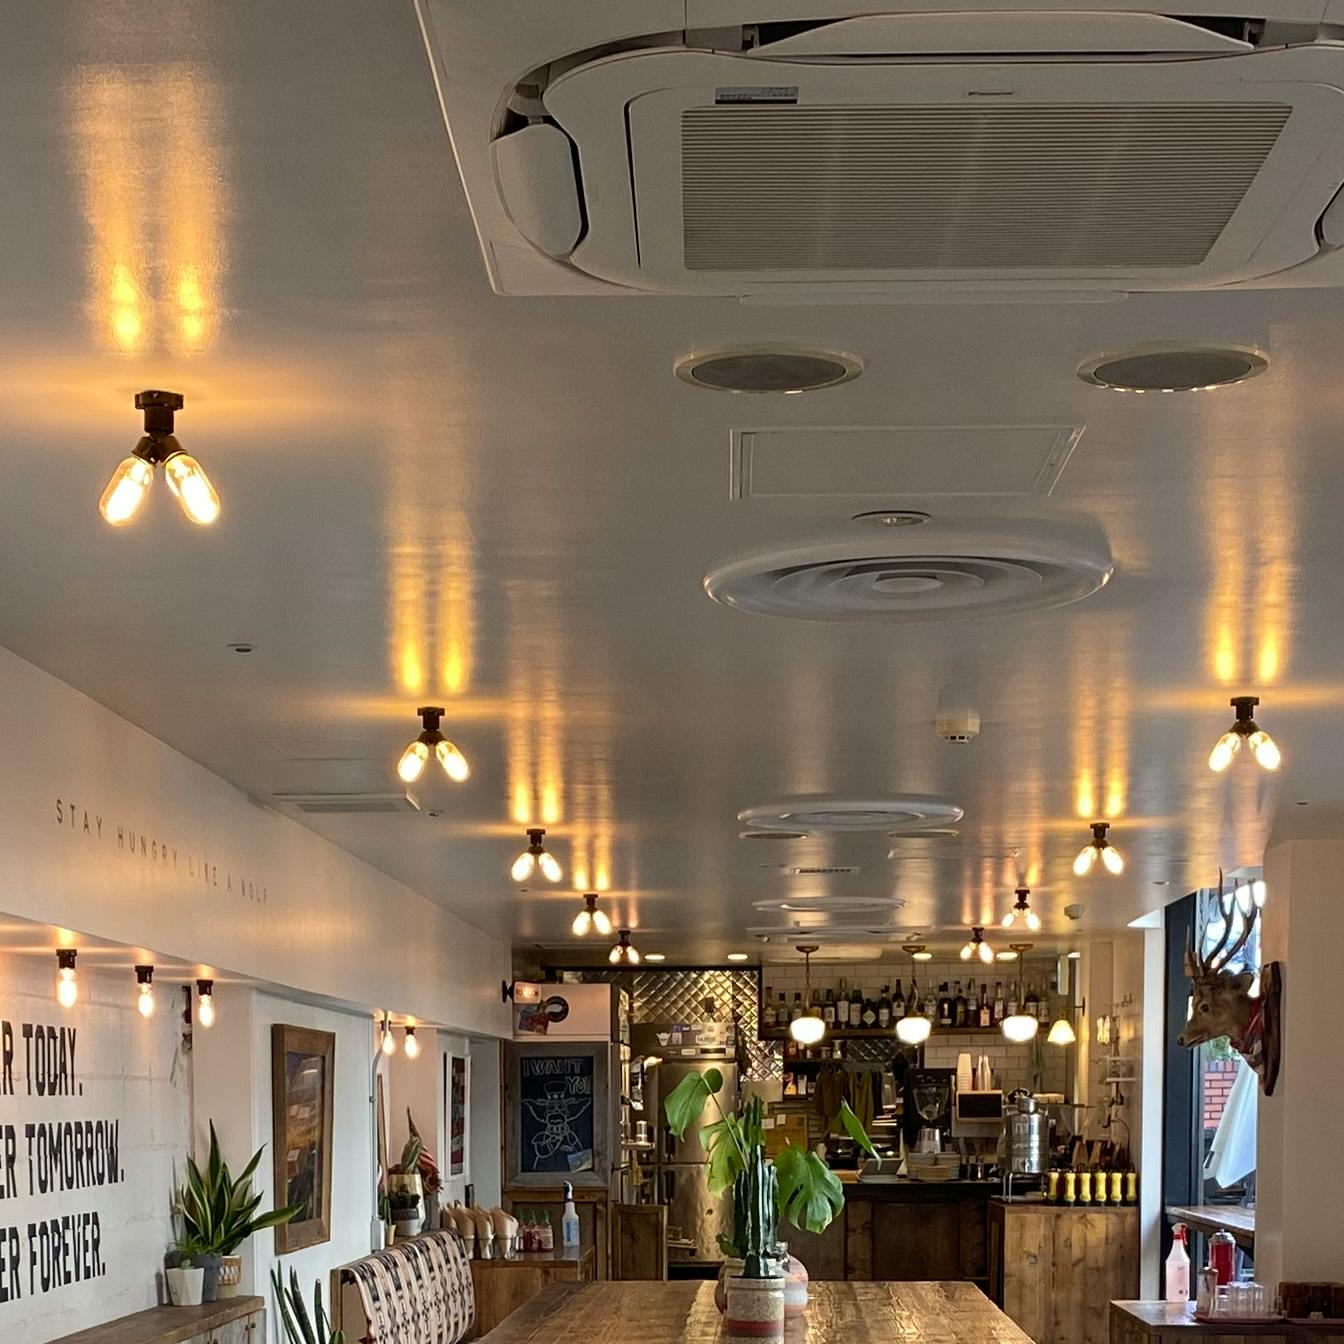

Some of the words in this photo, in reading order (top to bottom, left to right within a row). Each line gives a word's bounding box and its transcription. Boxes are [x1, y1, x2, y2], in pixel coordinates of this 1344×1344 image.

[56, 798, 102, 838] STAY
[117, 826, 177, 868] HUNGRY
[189, 855, 218, 886] LIKE
[22, 1023, 83, 1096] TODAY.
[523, 1059, 530, 1077] I
[531, 1058, 584, 1076] WANT
[25, 1119, 124, 1195] TOMORROW.
[27, 1211, 106, 1295] FOREVER.
